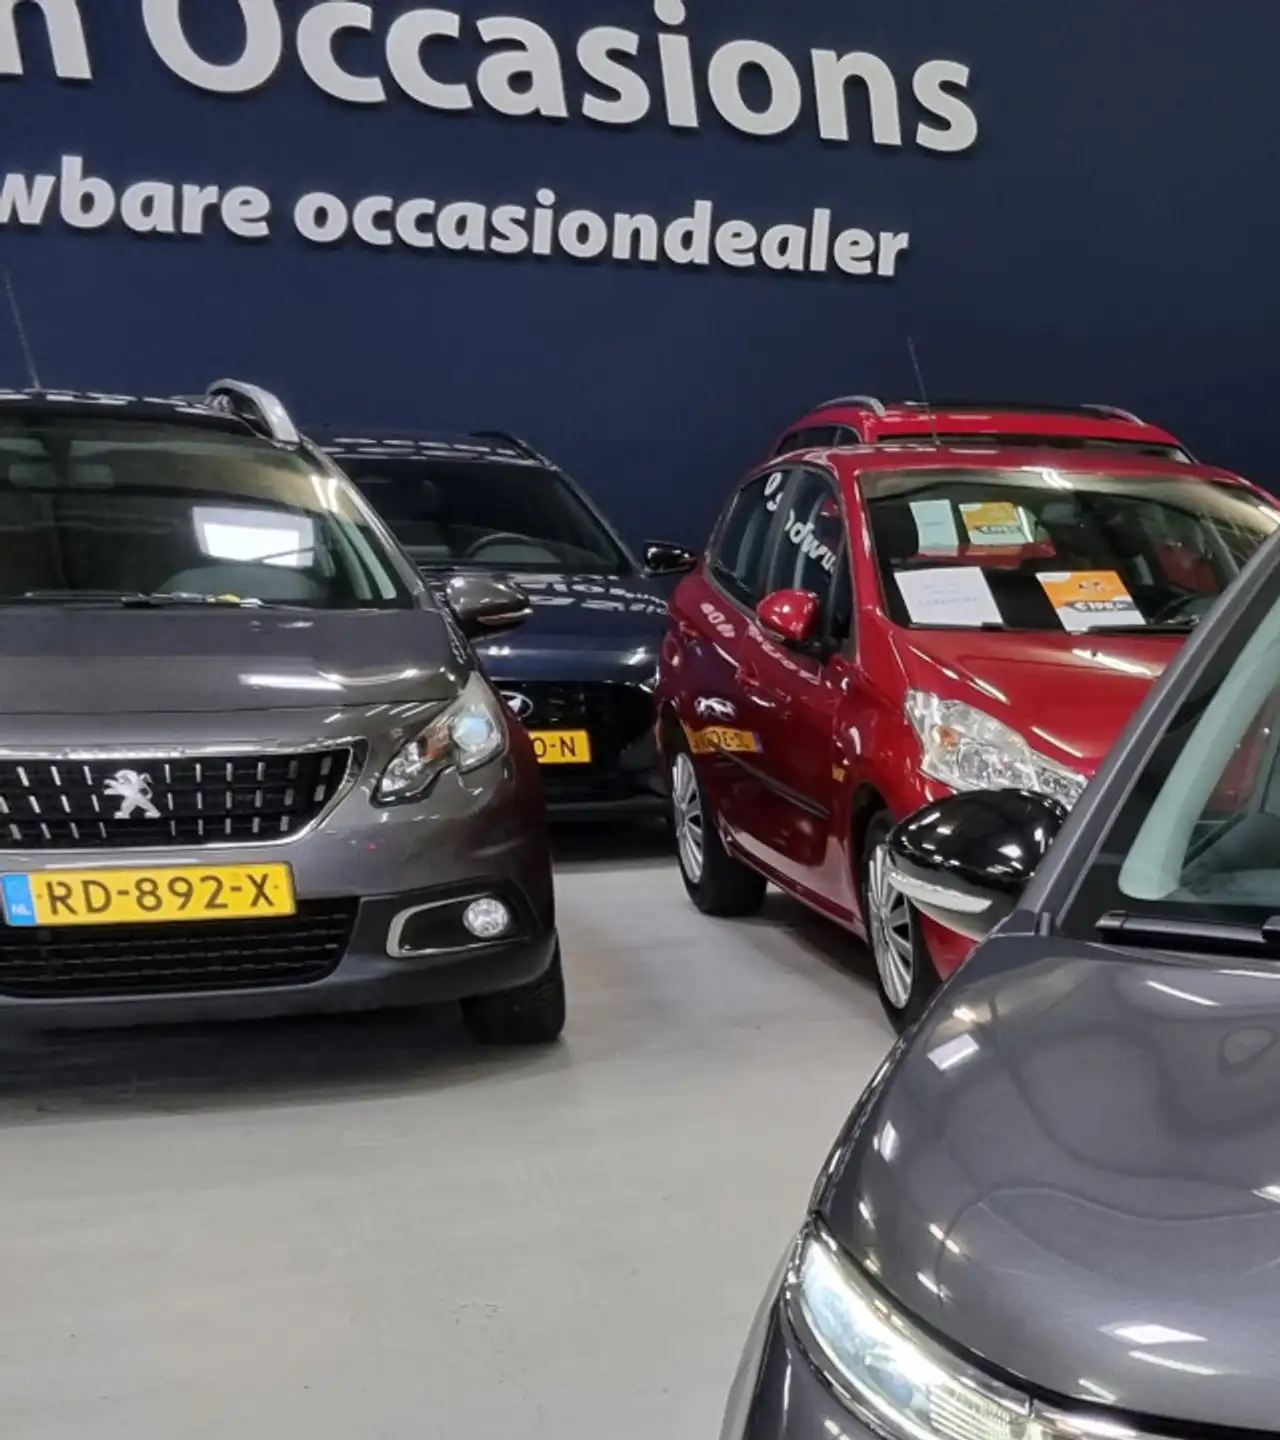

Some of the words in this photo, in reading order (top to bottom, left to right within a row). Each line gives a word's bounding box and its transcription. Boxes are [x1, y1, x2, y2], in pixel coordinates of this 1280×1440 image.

[143, 0, 979, 153] Occasions
[0, 155, 270, 240] wbare
[293, 189, 910, 276] occasiondealer
[46, 873, 275, 915] RD-892-X
